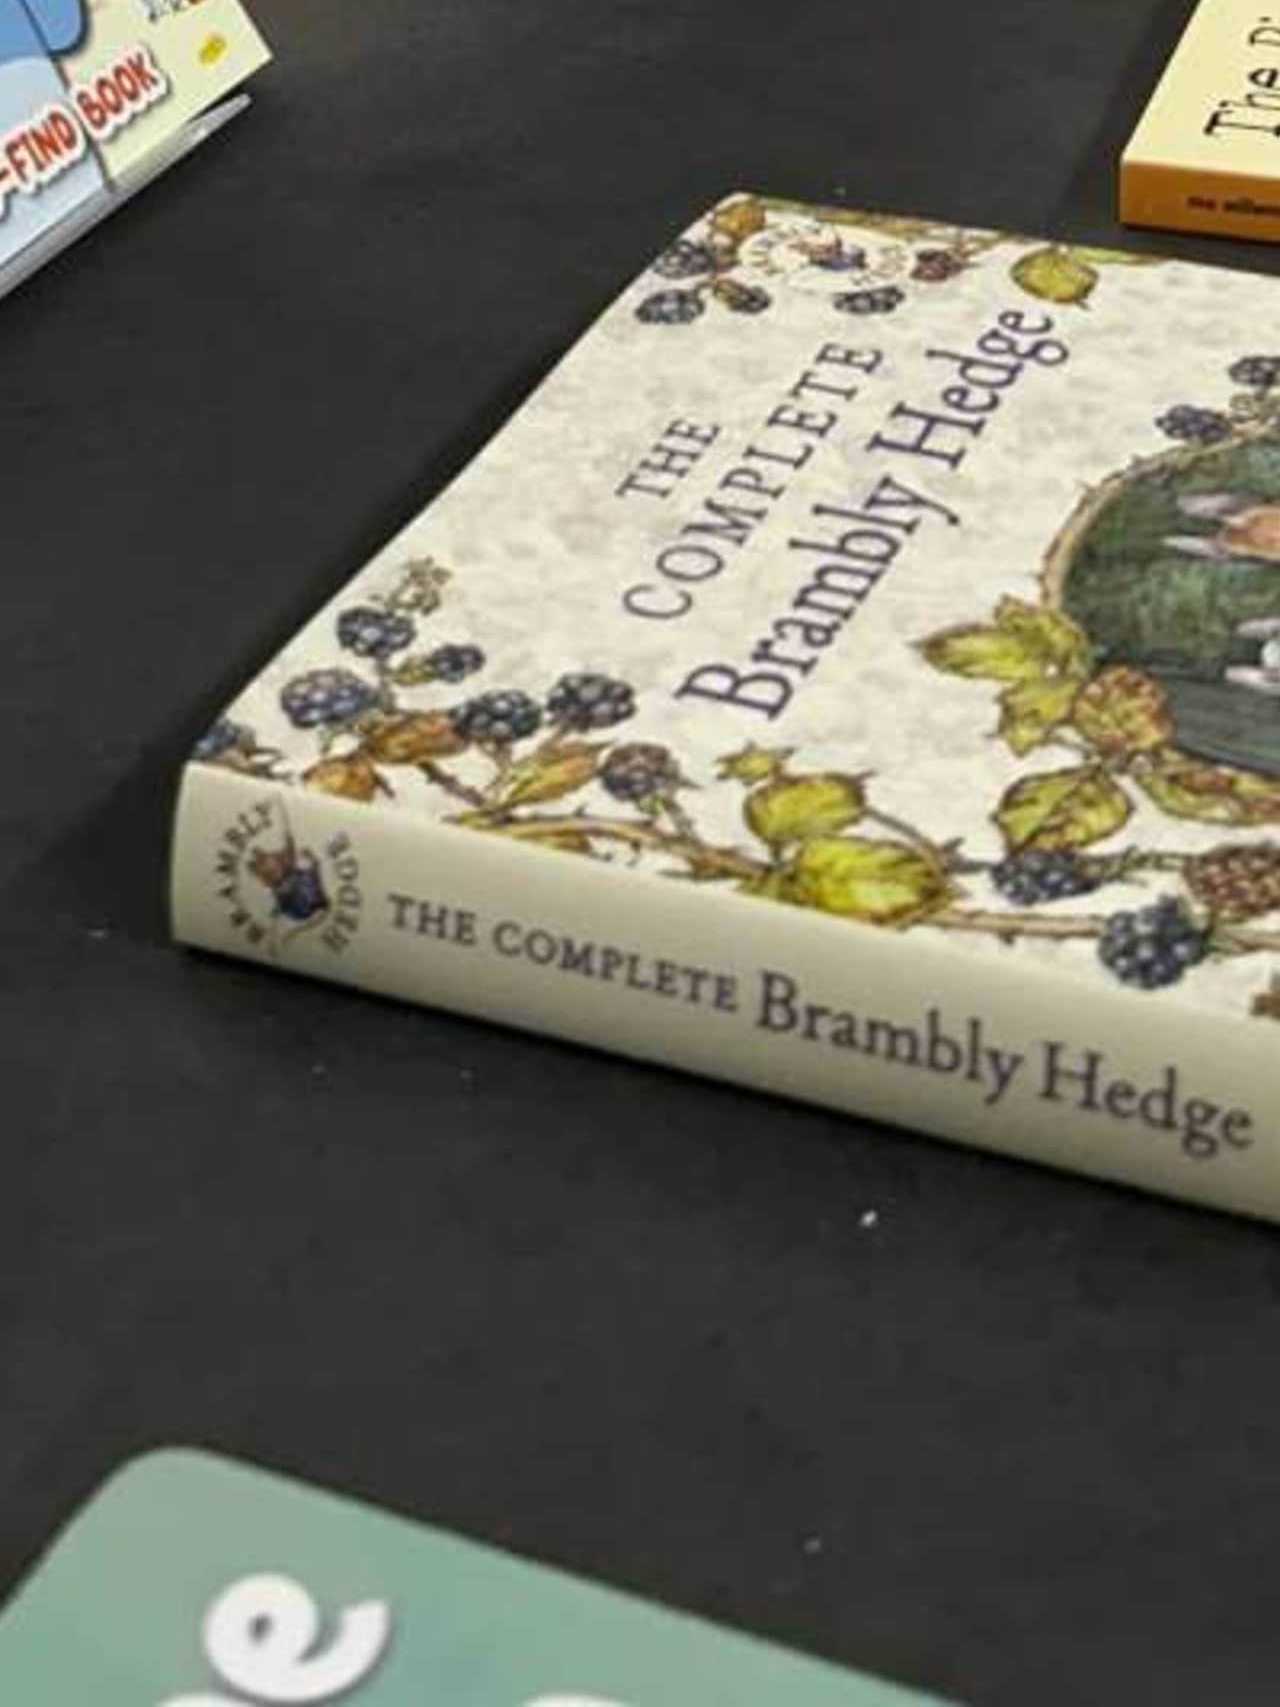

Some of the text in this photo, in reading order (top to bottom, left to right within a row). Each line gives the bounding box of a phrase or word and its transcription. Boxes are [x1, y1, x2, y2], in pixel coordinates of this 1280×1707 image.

[76, 52, 159, 129] BOOK
[614, 412, 720, 504] THE
[621, 337, 883, 623] COMPLETE
[674, 305, 1069, 723] Brambly Hedge
[387, 893, 478, 946] THE
[491, 920, 740, 1014] COMPLETE
[755, 970, 1025, 1106] Brambly
[1038, 1040, 1256, 1160] Hedge
